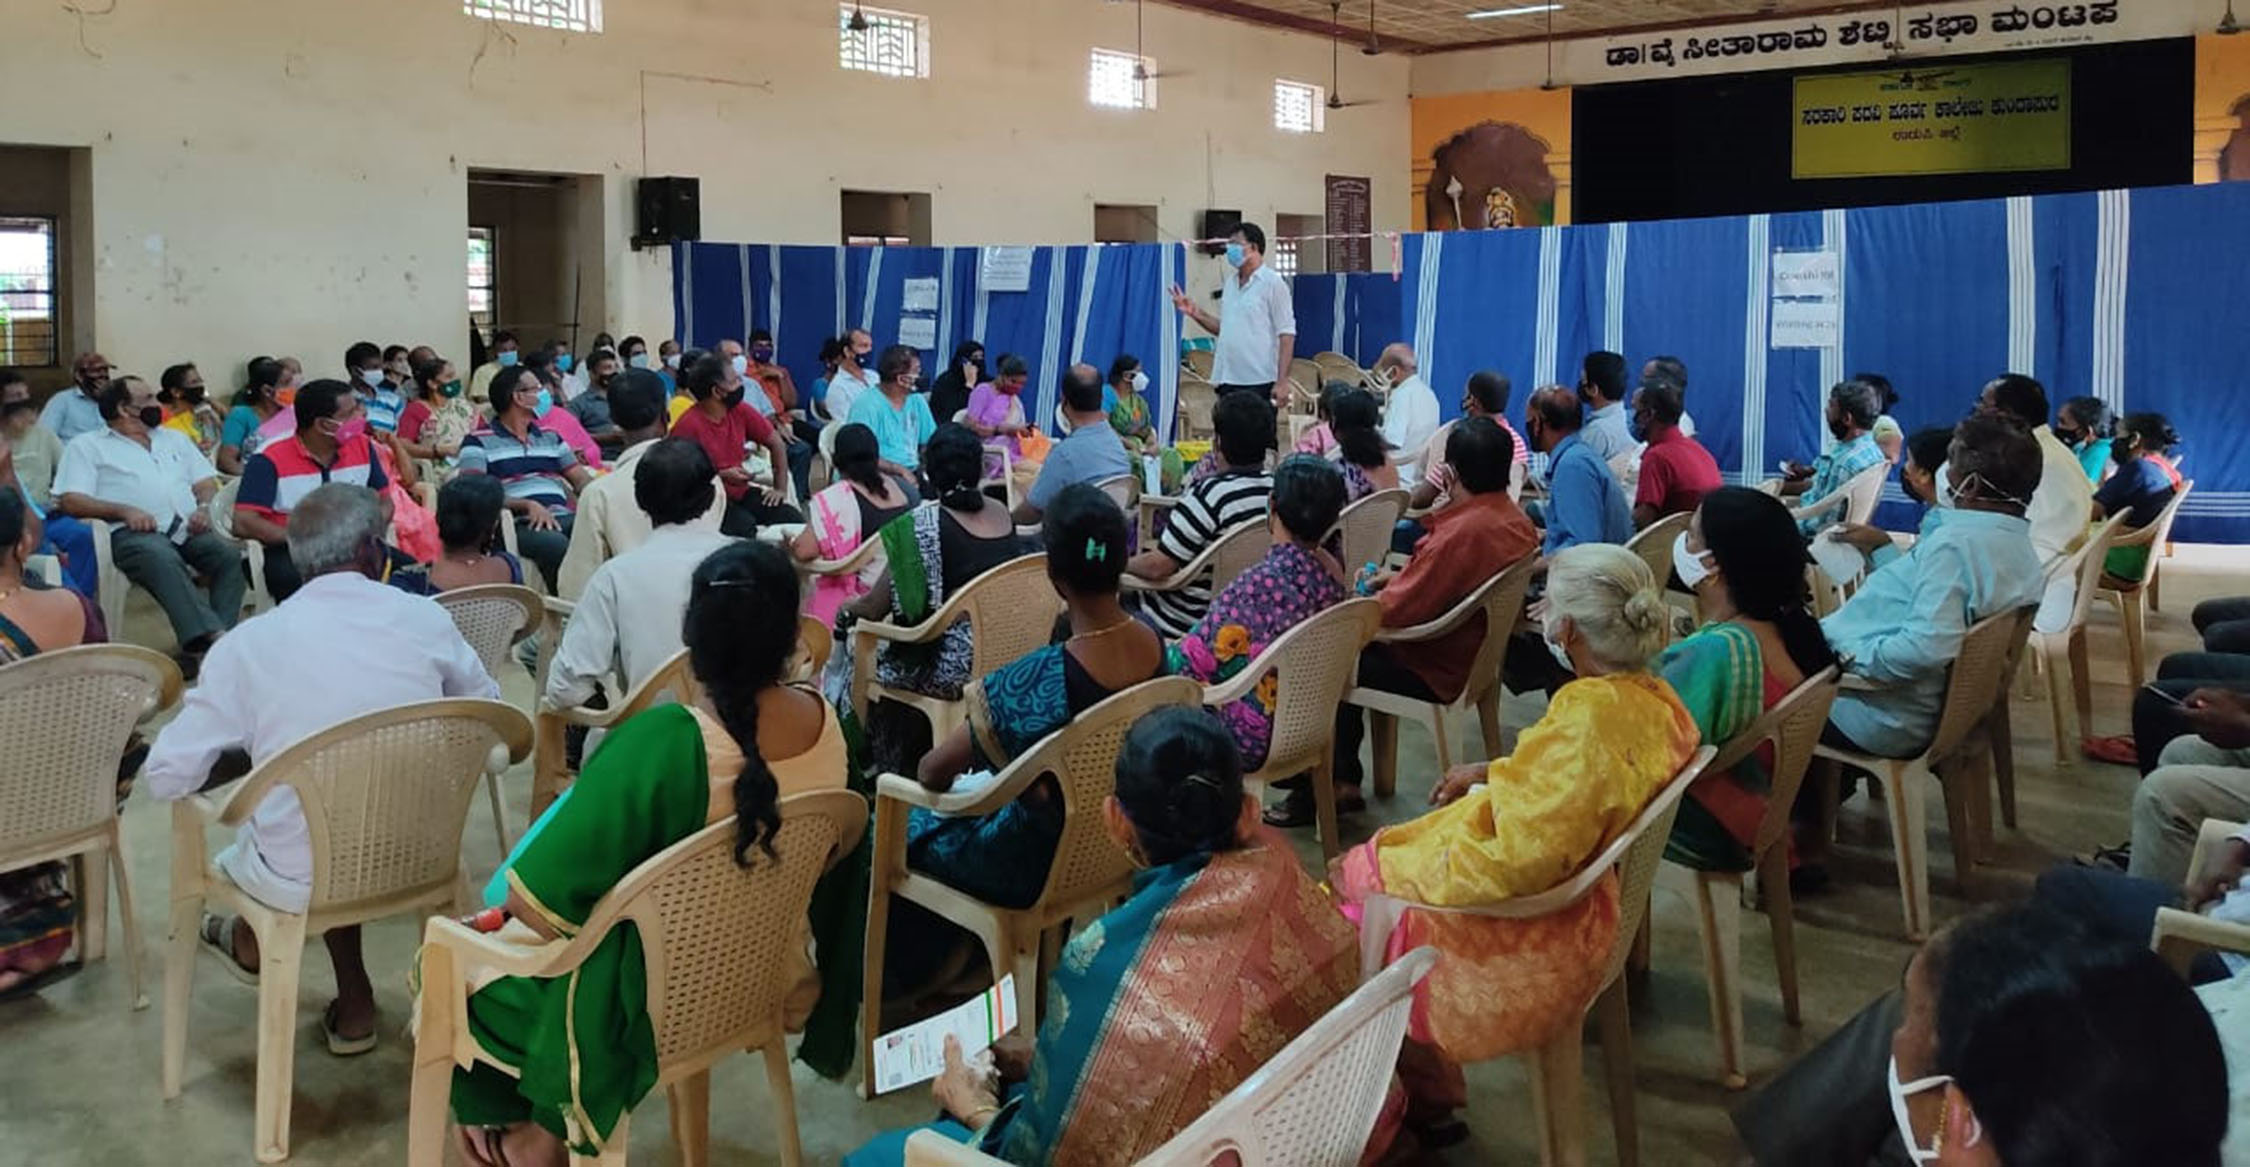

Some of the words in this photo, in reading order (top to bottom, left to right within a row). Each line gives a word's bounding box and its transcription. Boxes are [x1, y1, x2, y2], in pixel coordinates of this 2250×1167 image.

[1683, 24, 1828, 60] ಸೀತಾರಾಮ
[1908, 12, 1978, 42] ಸಭಾ
[1991, 0, 2119, 32] ಮಂಟಪ
